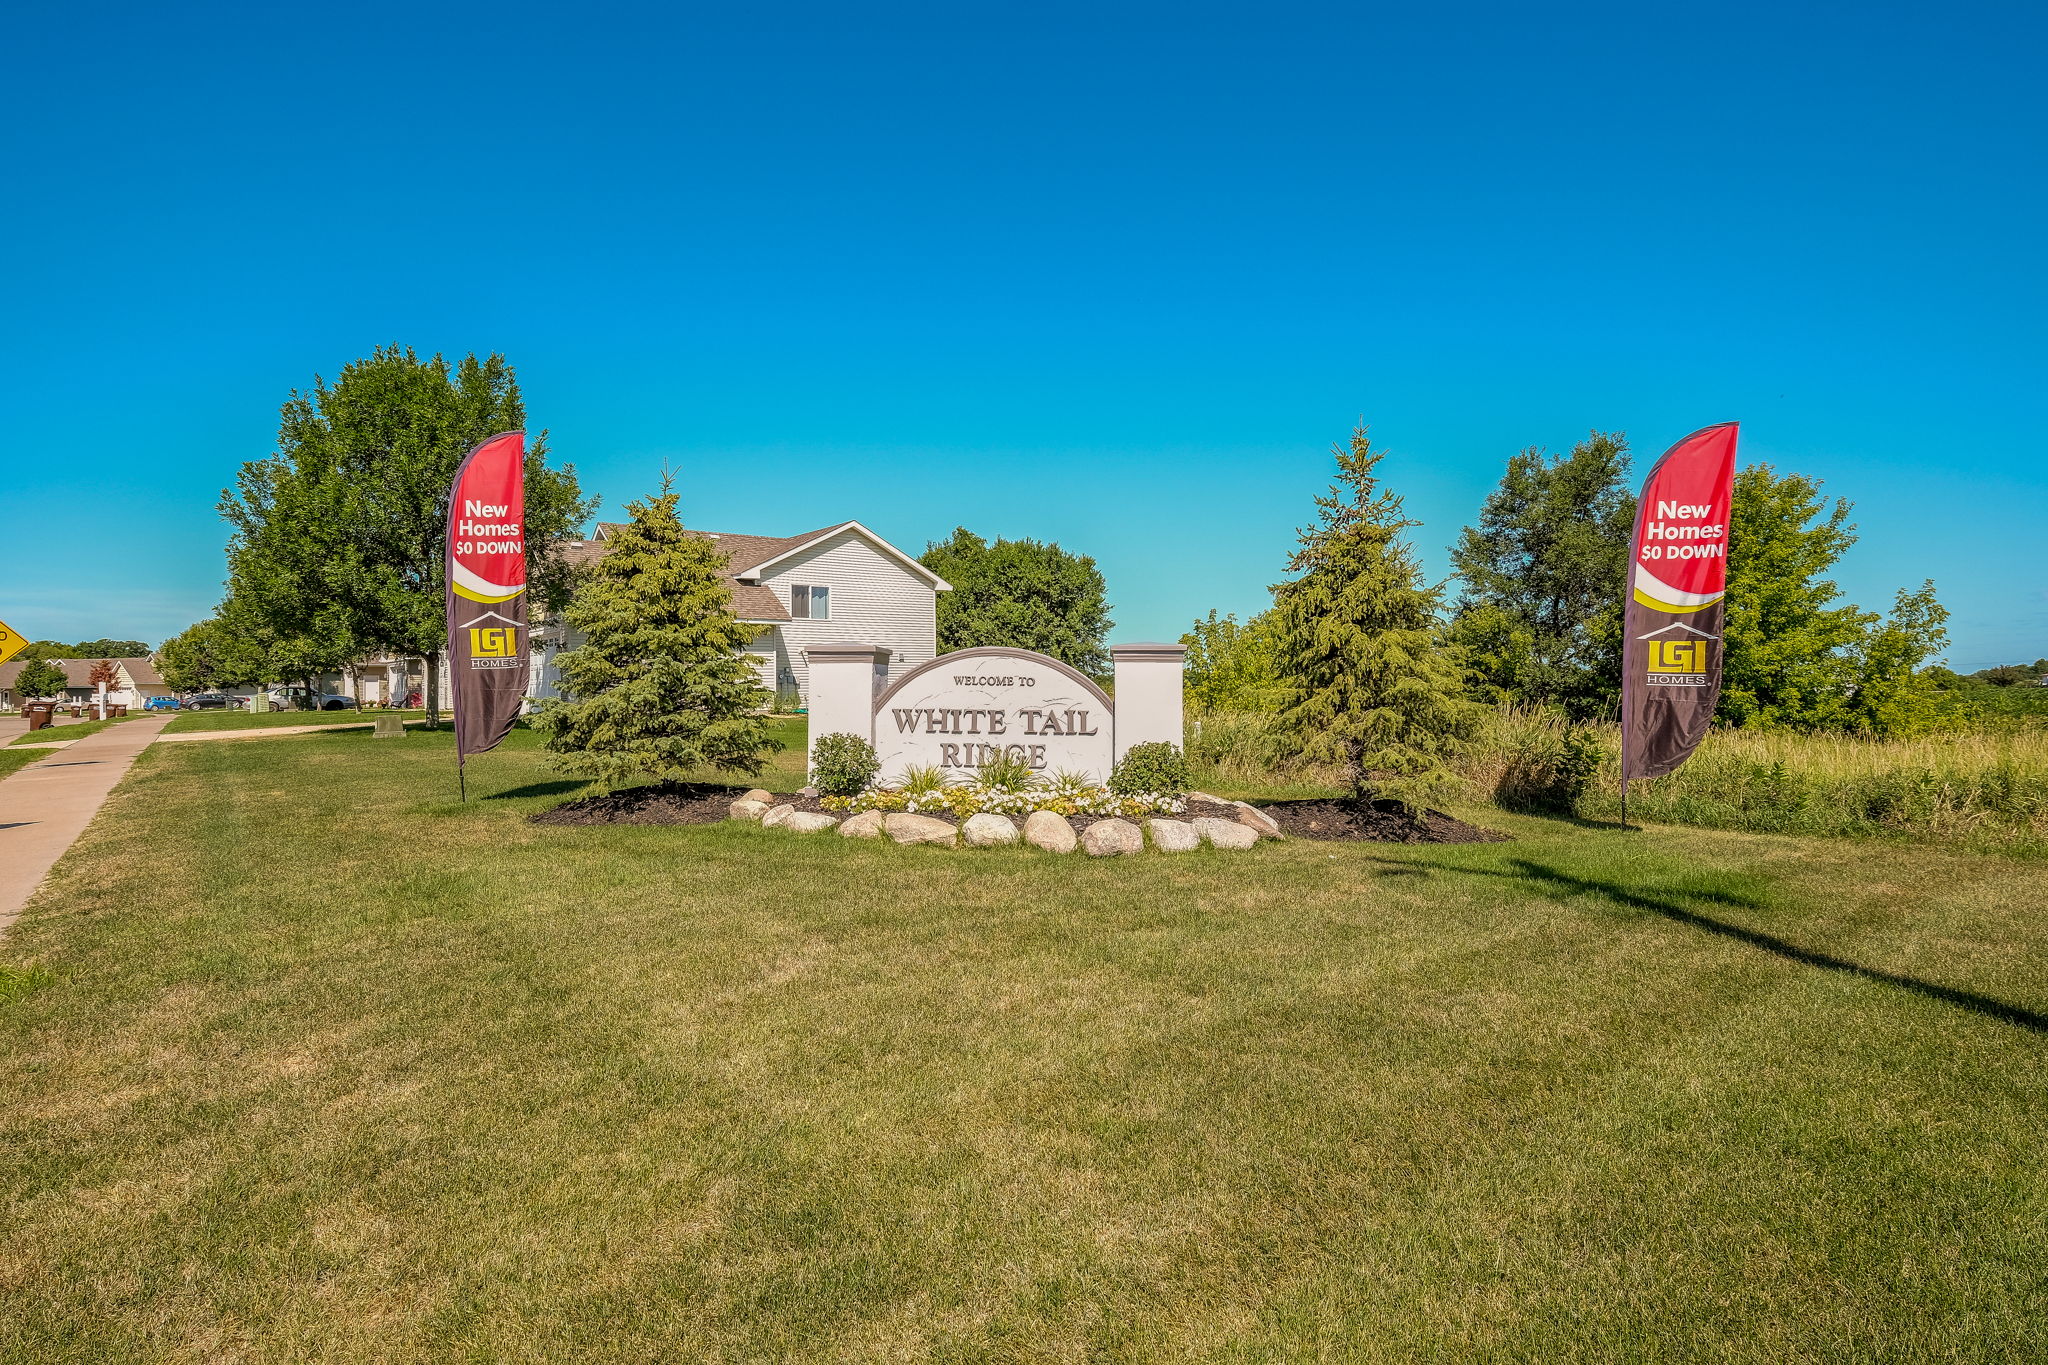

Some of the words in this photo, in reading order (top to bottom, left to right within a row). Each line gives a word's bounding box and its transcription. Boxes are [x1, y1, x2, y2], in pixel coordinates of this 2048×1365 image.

[464, 499, 508, 518] New
[1657, 500, 1712, 519] New
[459, 519, 520, 536] Homes
[1647, 521, 1724, 540] Homes
[456, 540, 473, 556] $0
[476, 541, 522, 555] DOWN
[1641, 544, 1662, 561] $0
[1666, 543, 1724, 560] DOWN
[469, 627, 517, 657] LGI
[471, 659, 518, 668] HOMES
[1647, 640, 1707, 673] LGI
[953, 675, 1015, 687] WELCOME
[1018, 676, 1036, 687] TO
[1647, 675, 1706, 684] HOMES
[891, 708, 1007, 735] WHITE
[1019, 709, 1099, 736] TAIL
